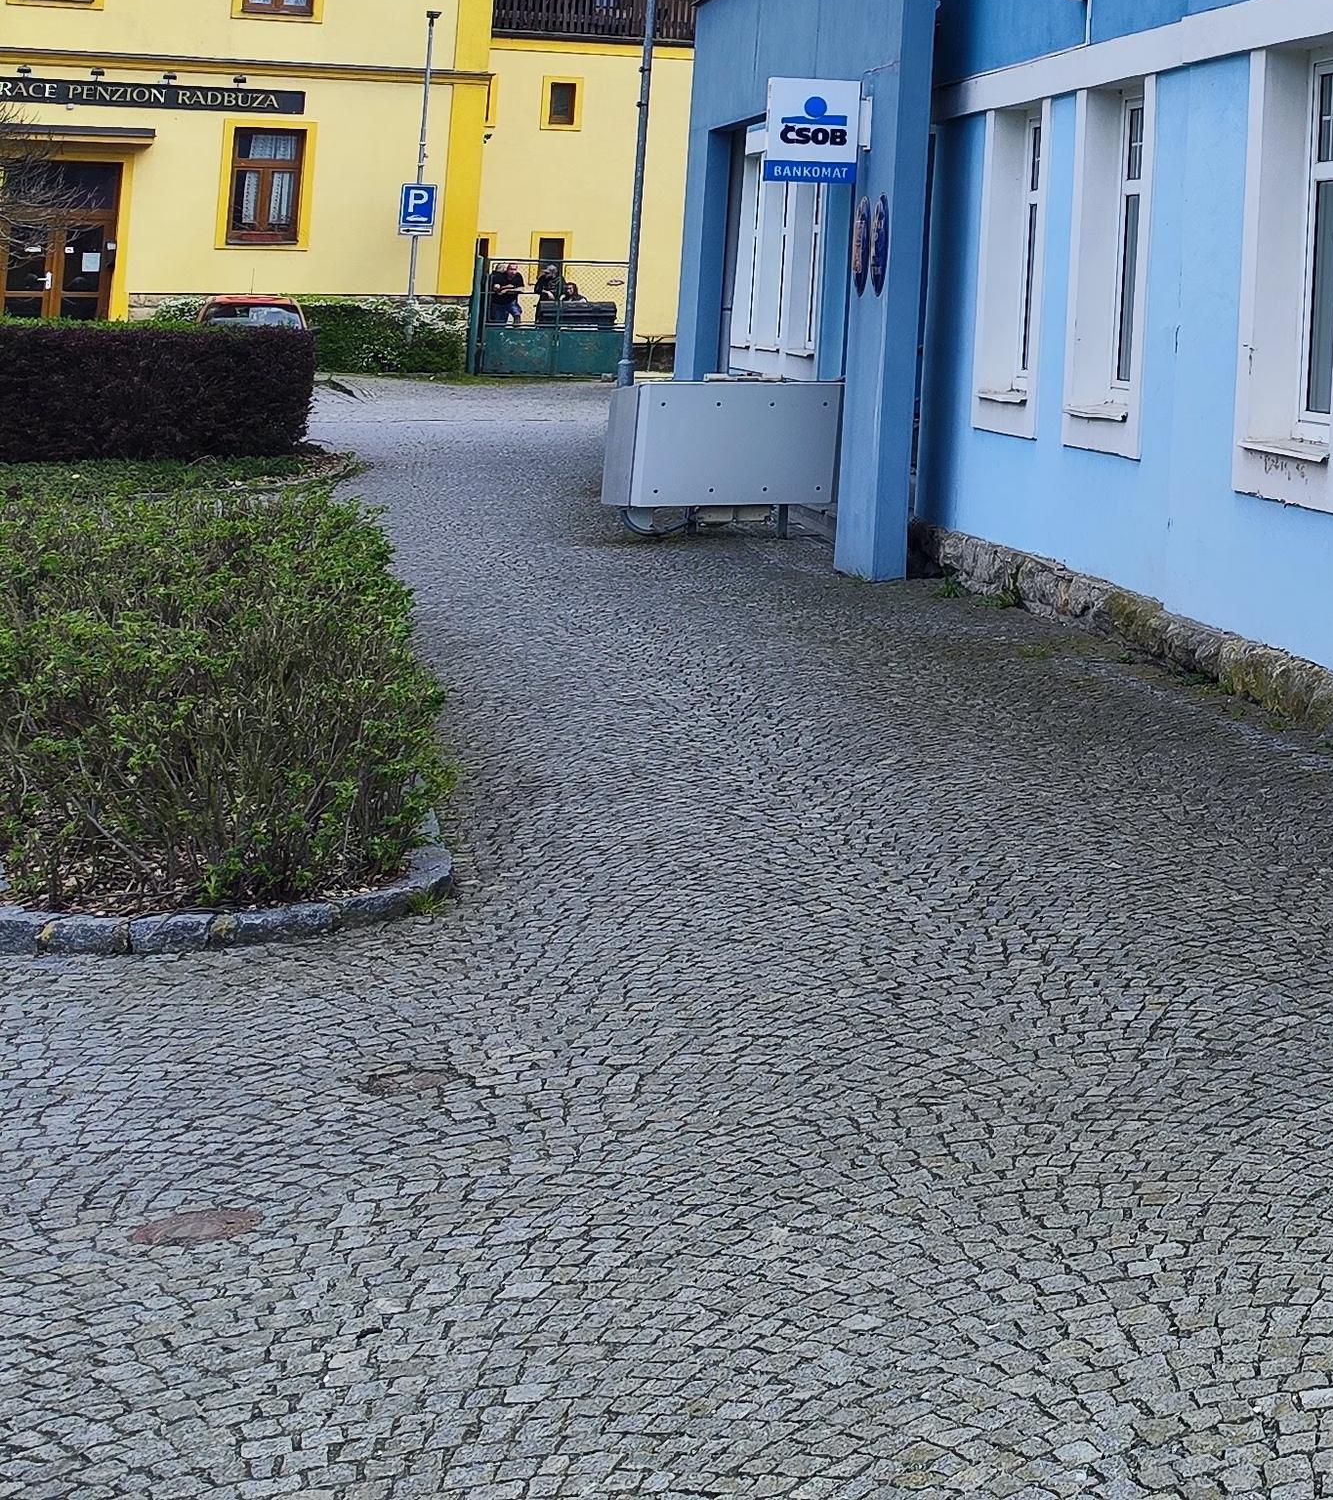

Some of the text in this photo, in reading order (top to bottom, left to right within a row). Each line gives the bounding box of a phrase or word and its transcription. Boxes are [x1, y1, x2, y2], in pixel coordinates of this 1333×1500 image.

[68, 84, 167, 104] PENZION
[177, 89, 280, 109] RADBUZA
[780, 124, 848, 146] ČSOB
[773, 165, 849, 179] BANKOMAT
[407, 189, 429, 213] P
